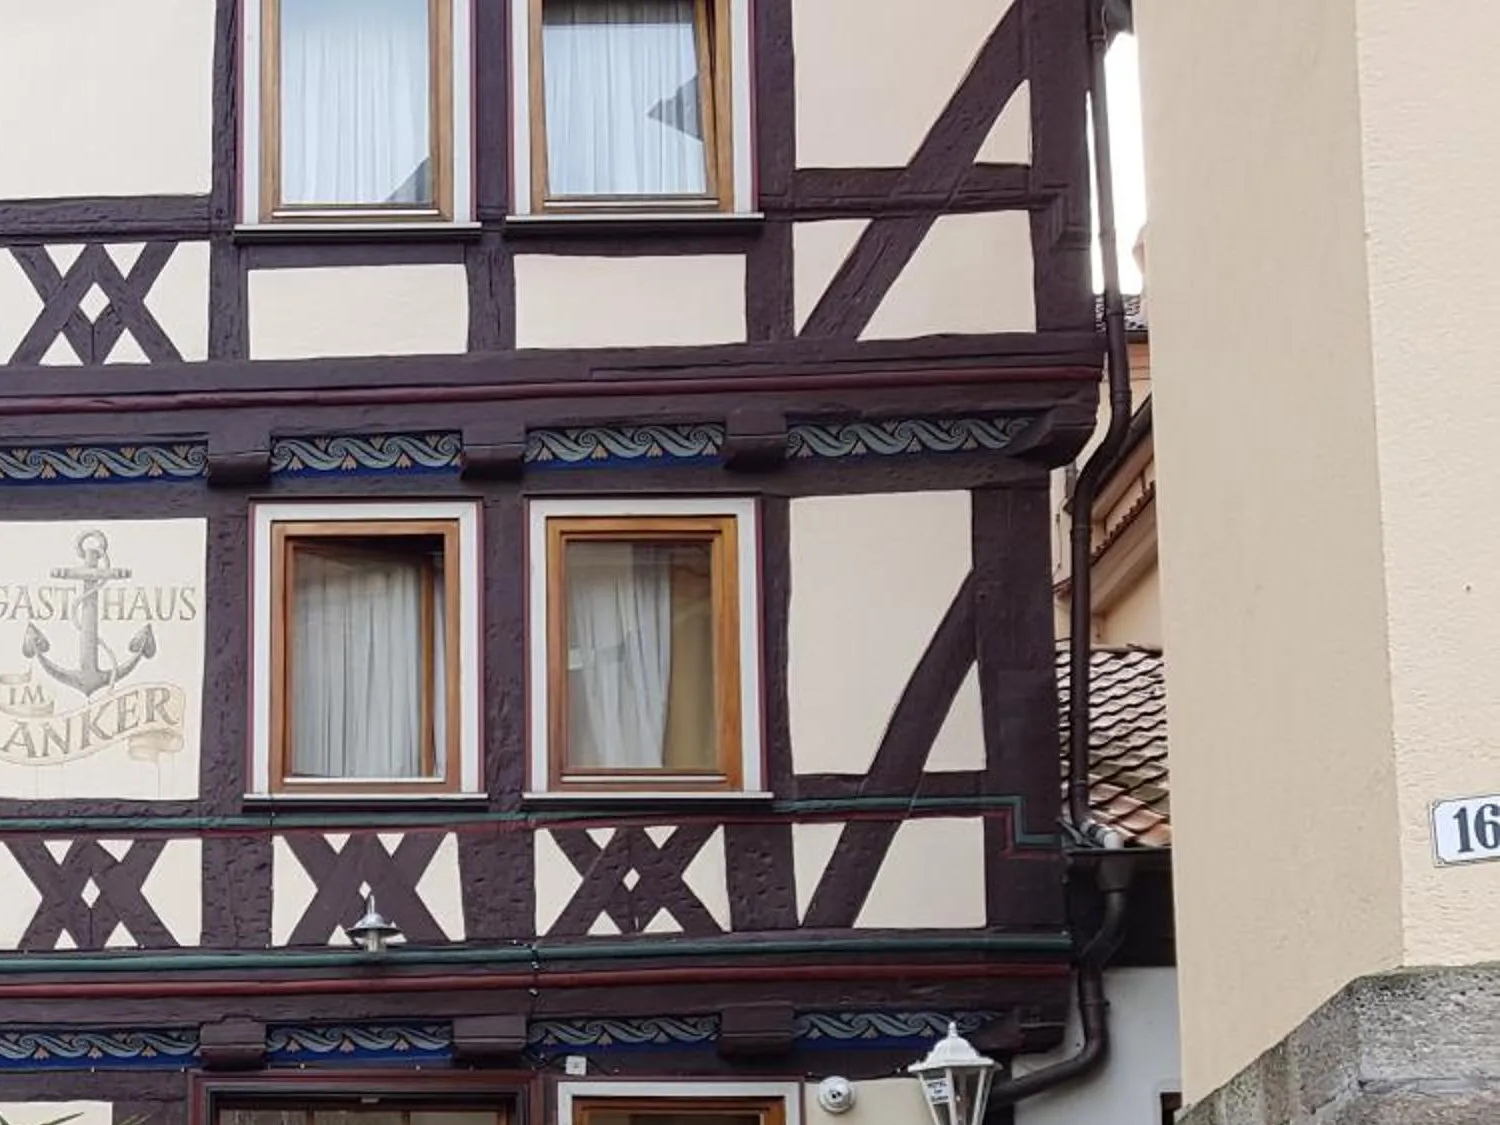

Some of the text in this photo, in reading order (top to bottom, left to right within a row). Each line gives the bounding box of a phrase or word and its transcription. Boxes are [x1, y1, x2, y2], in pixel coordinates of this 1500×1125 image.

[7, 684, 46, 706] IM
[0, 686, 180, 759] ANKER
[1452, 803, 1500, 853] 16
